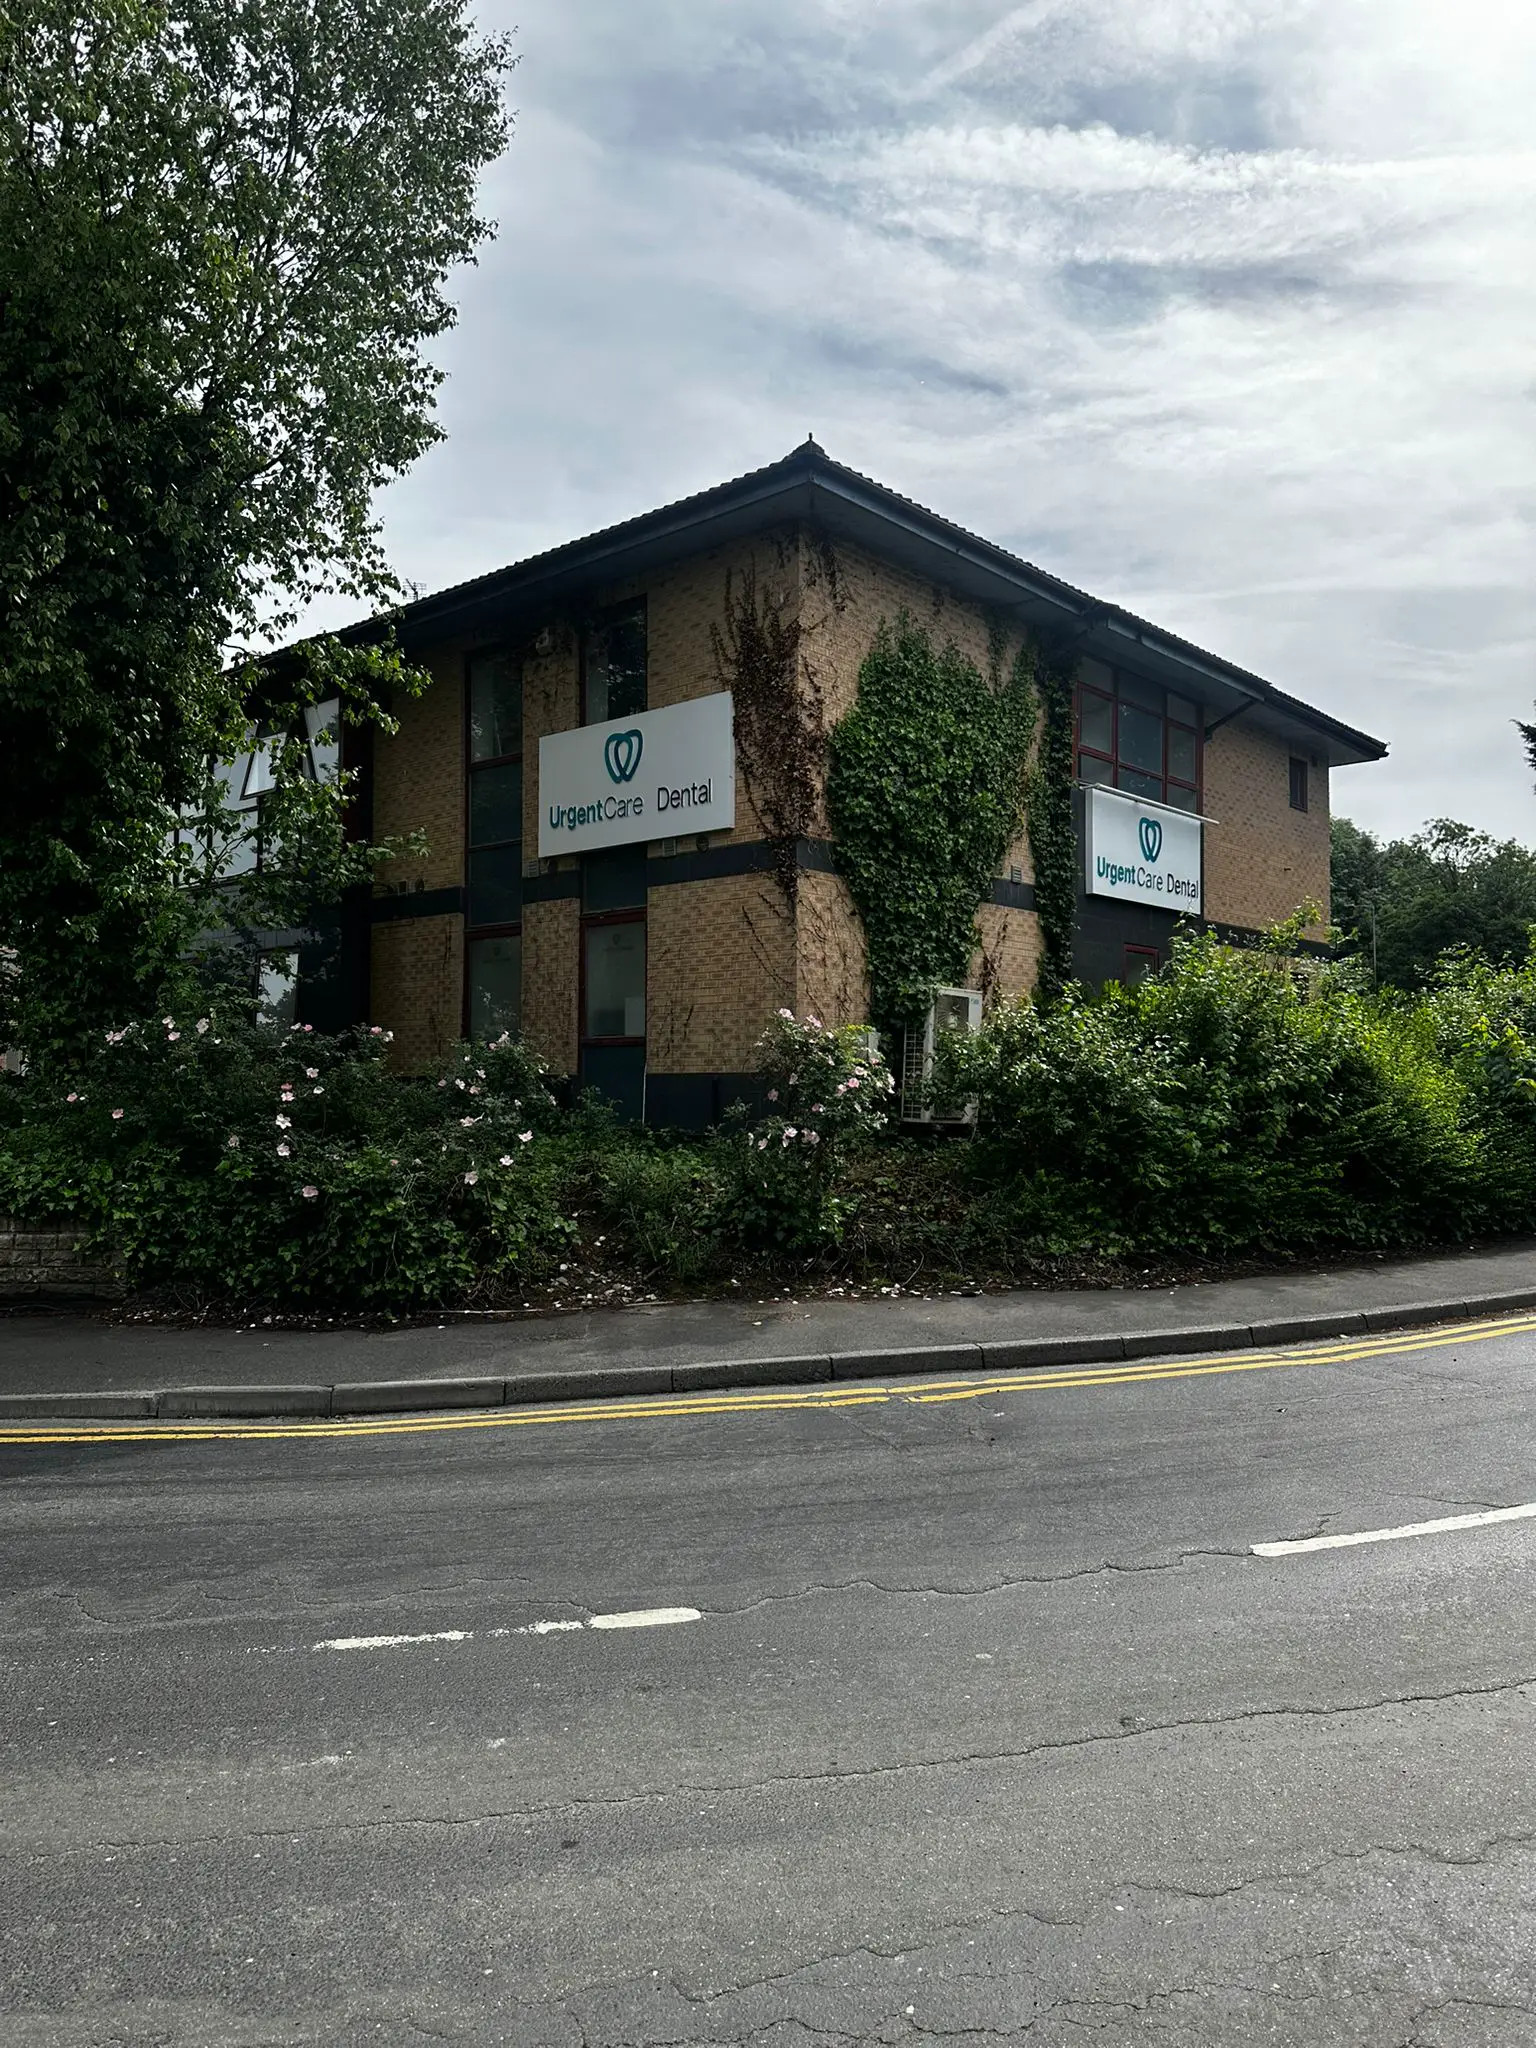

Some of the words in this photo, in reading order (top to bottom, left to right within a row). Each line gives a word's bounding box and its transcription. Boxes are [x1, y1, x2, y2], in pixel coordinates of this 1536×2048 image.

[549, 796, 644, 831] UrgentCare
[657, 778, 713, 812] Dental
[1166, 873, 1199, 899] Dental
